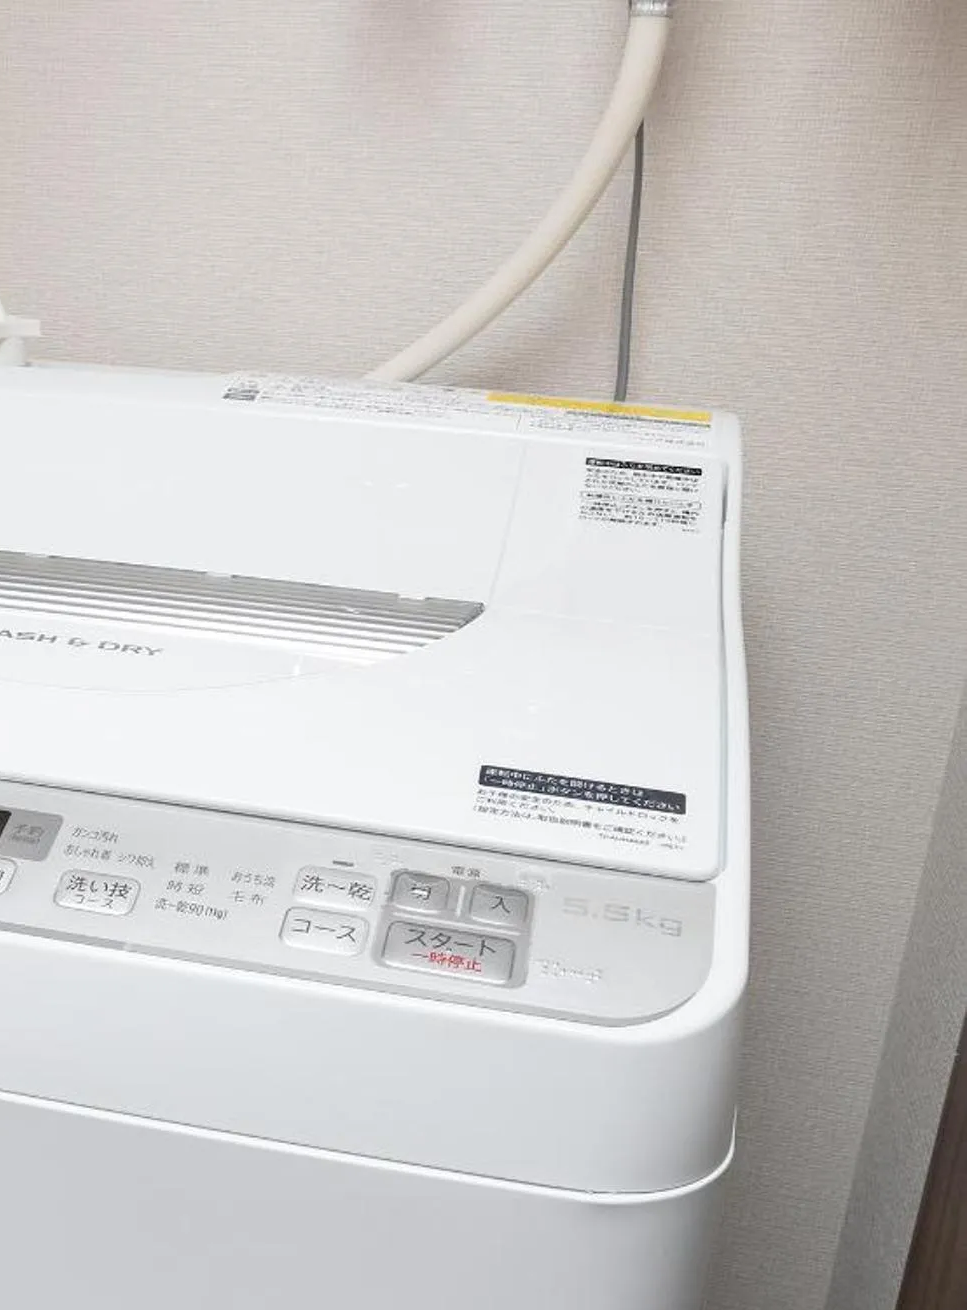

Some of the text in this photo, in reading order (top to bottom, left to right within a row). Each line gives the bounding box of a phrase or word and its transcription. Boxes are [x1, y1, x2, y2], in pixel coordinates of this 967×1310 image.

[67, 637, 90, 647] &
[98, 640, 165, 656] DRY
[451, 866, 481, 878] 電源
[66, 875, 132, 899] 洗い技
[75, 895, 115, 909] コース
[491, 895, 511, 914] 入
[291, 918, 356, 943] コース
[404, 928, 497, 957] スタート
[411, 952, 482, 973] 一時停止
